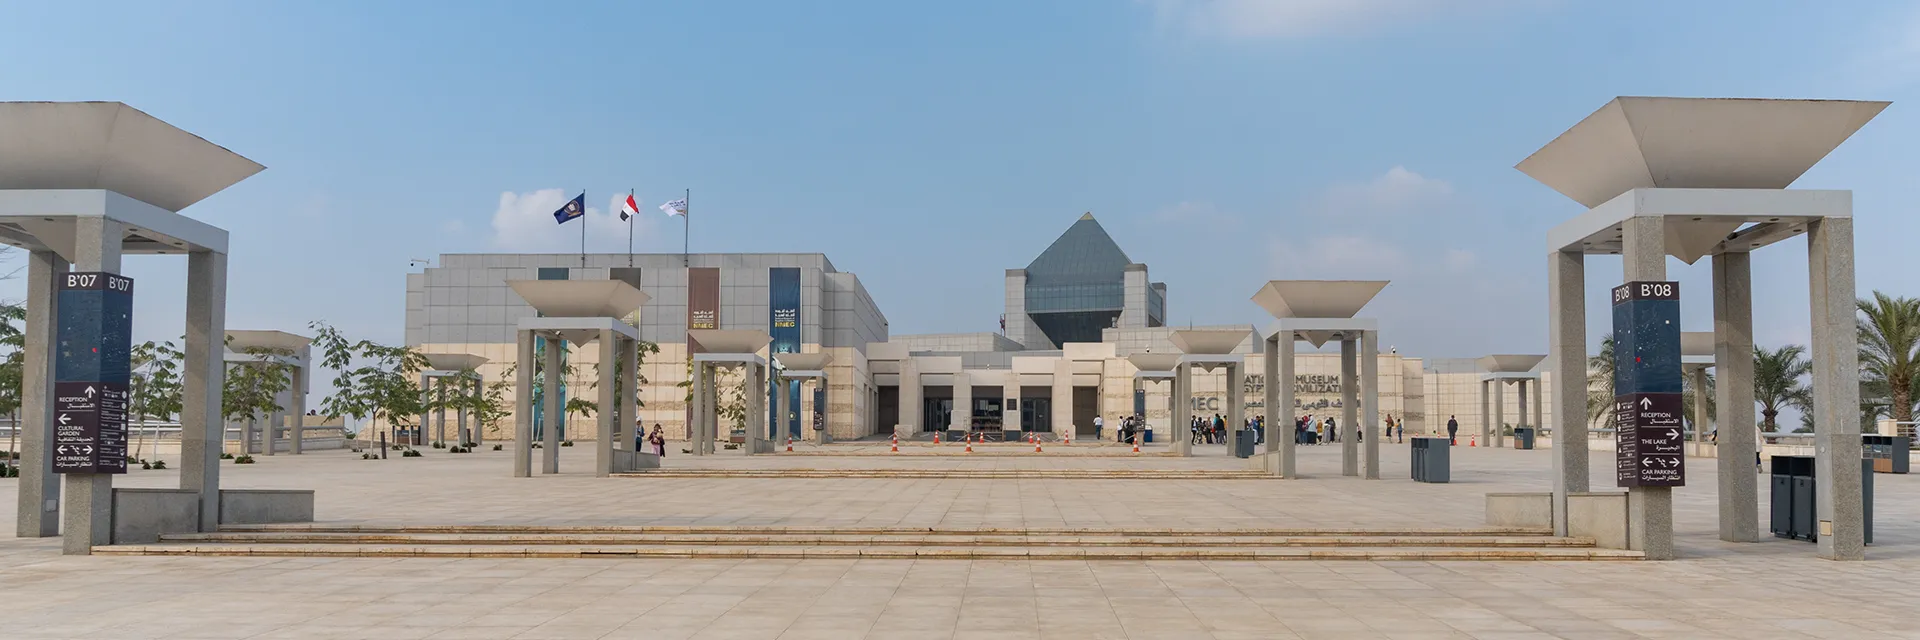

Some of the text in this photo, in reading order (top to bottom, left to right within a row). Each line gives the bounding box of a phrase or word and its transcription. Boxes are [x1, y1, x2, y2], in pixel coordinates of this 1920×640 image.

[68, 274, 97, 287] B'07
[109, 276, 130, 292] B'07
[1615, 285, 1630, 302] B'08
[1641, 284, 1672, 297] B'08
[1295, 375, 1339, 384] MUSEUM
